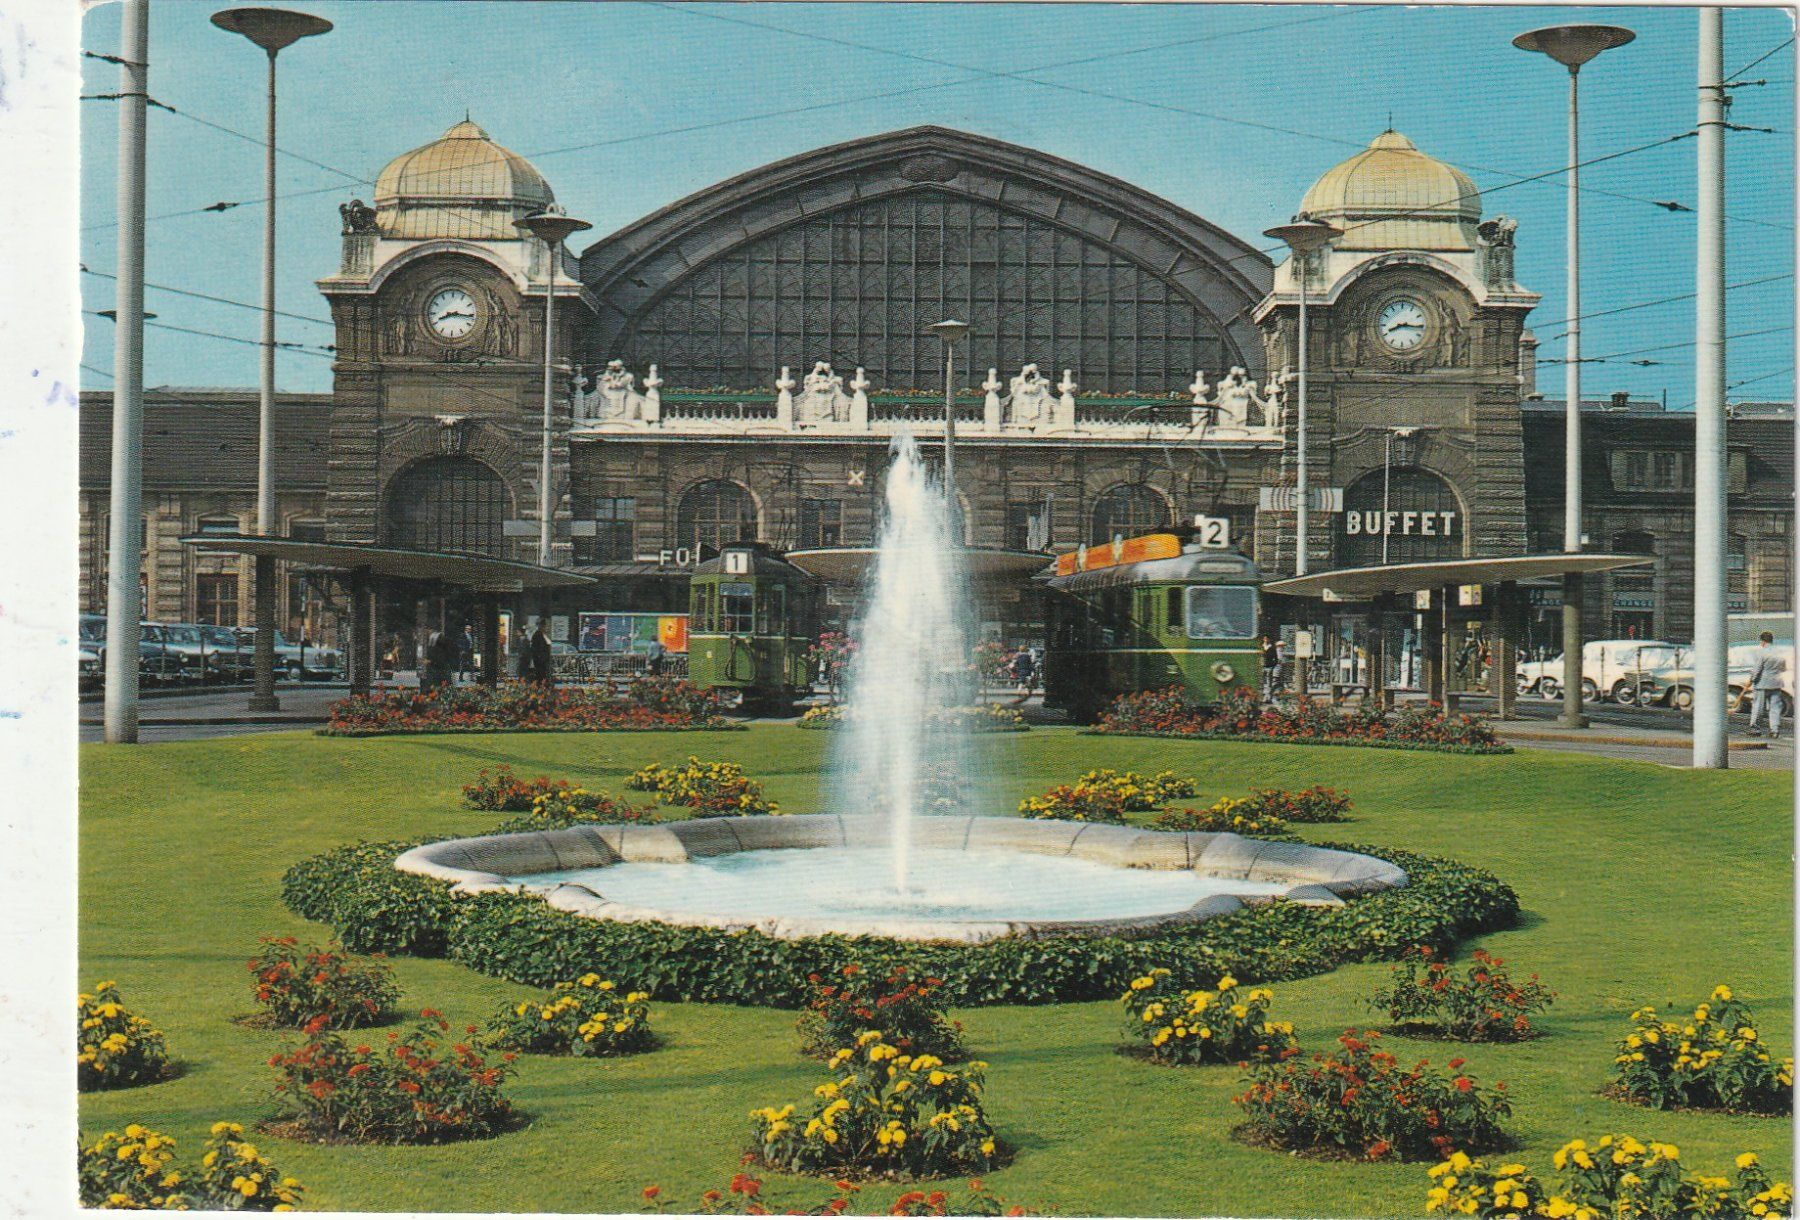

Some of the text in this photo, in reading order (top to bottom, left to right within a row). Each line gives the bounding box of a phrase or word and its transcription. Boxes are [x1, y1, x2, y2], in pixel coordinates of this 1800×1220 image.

[1207, 521, 1222, 545] 2
[1346, 511, 1456, 536] BUFFET
[732, 554, 739, 572] 1
